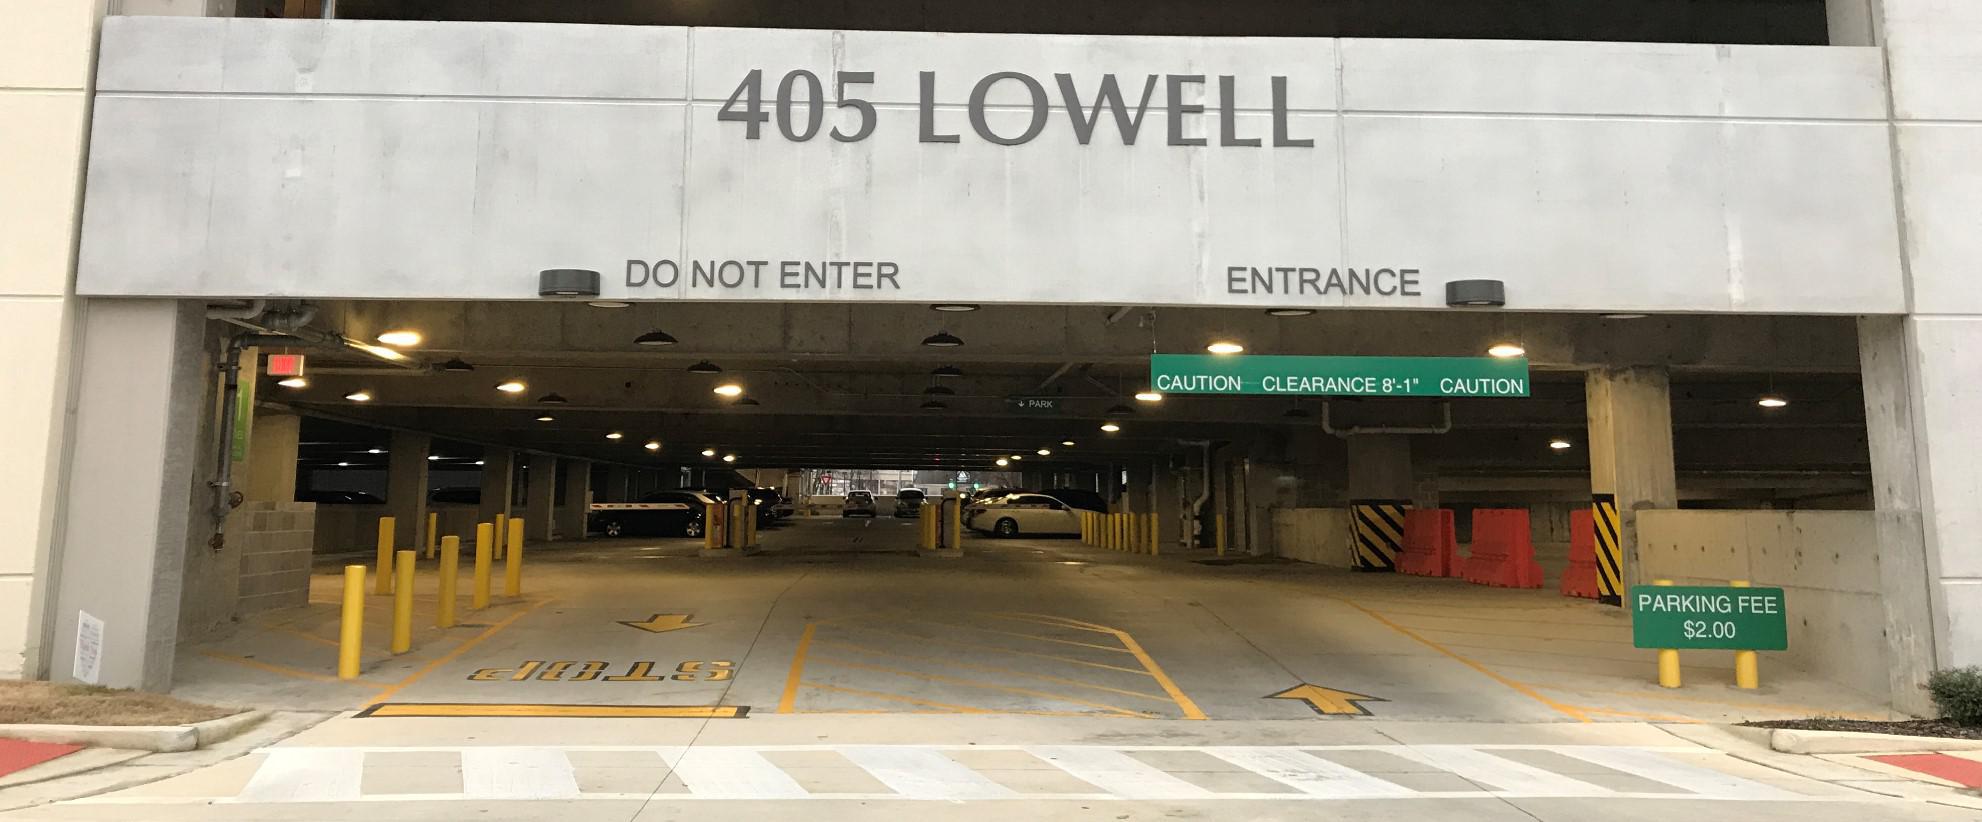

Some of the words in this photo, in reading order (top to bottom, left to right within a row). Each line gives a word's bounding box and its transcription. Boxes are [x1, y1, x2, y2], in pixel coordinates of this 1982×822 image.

[717, 69, 877, 142] 405
[919, 71, 1314, 147] LOWELL
[625, 259, 679, 287] DO
[692, 260, 768, 288] NOT
[780, 261, 900, 289] ENTER
[1227, 266, 1421, 296] ENTRANCE
[1157, 374, 1242, 391] CAUTION
[1262, 376, 1376, 393] CLEARANCE
[1382, 378, 1419, 393] 8'-1"
[1440, 378, 1524, 394] CAUTION
[1029, 400, 1053, 408] PARK
[1638, 594, 1732, 613] PARKING
[1738, 596, 1778, 614] FEE
[1683, 619, 1736, 640] $2.00
[467, 660, 737, 682] STOP
